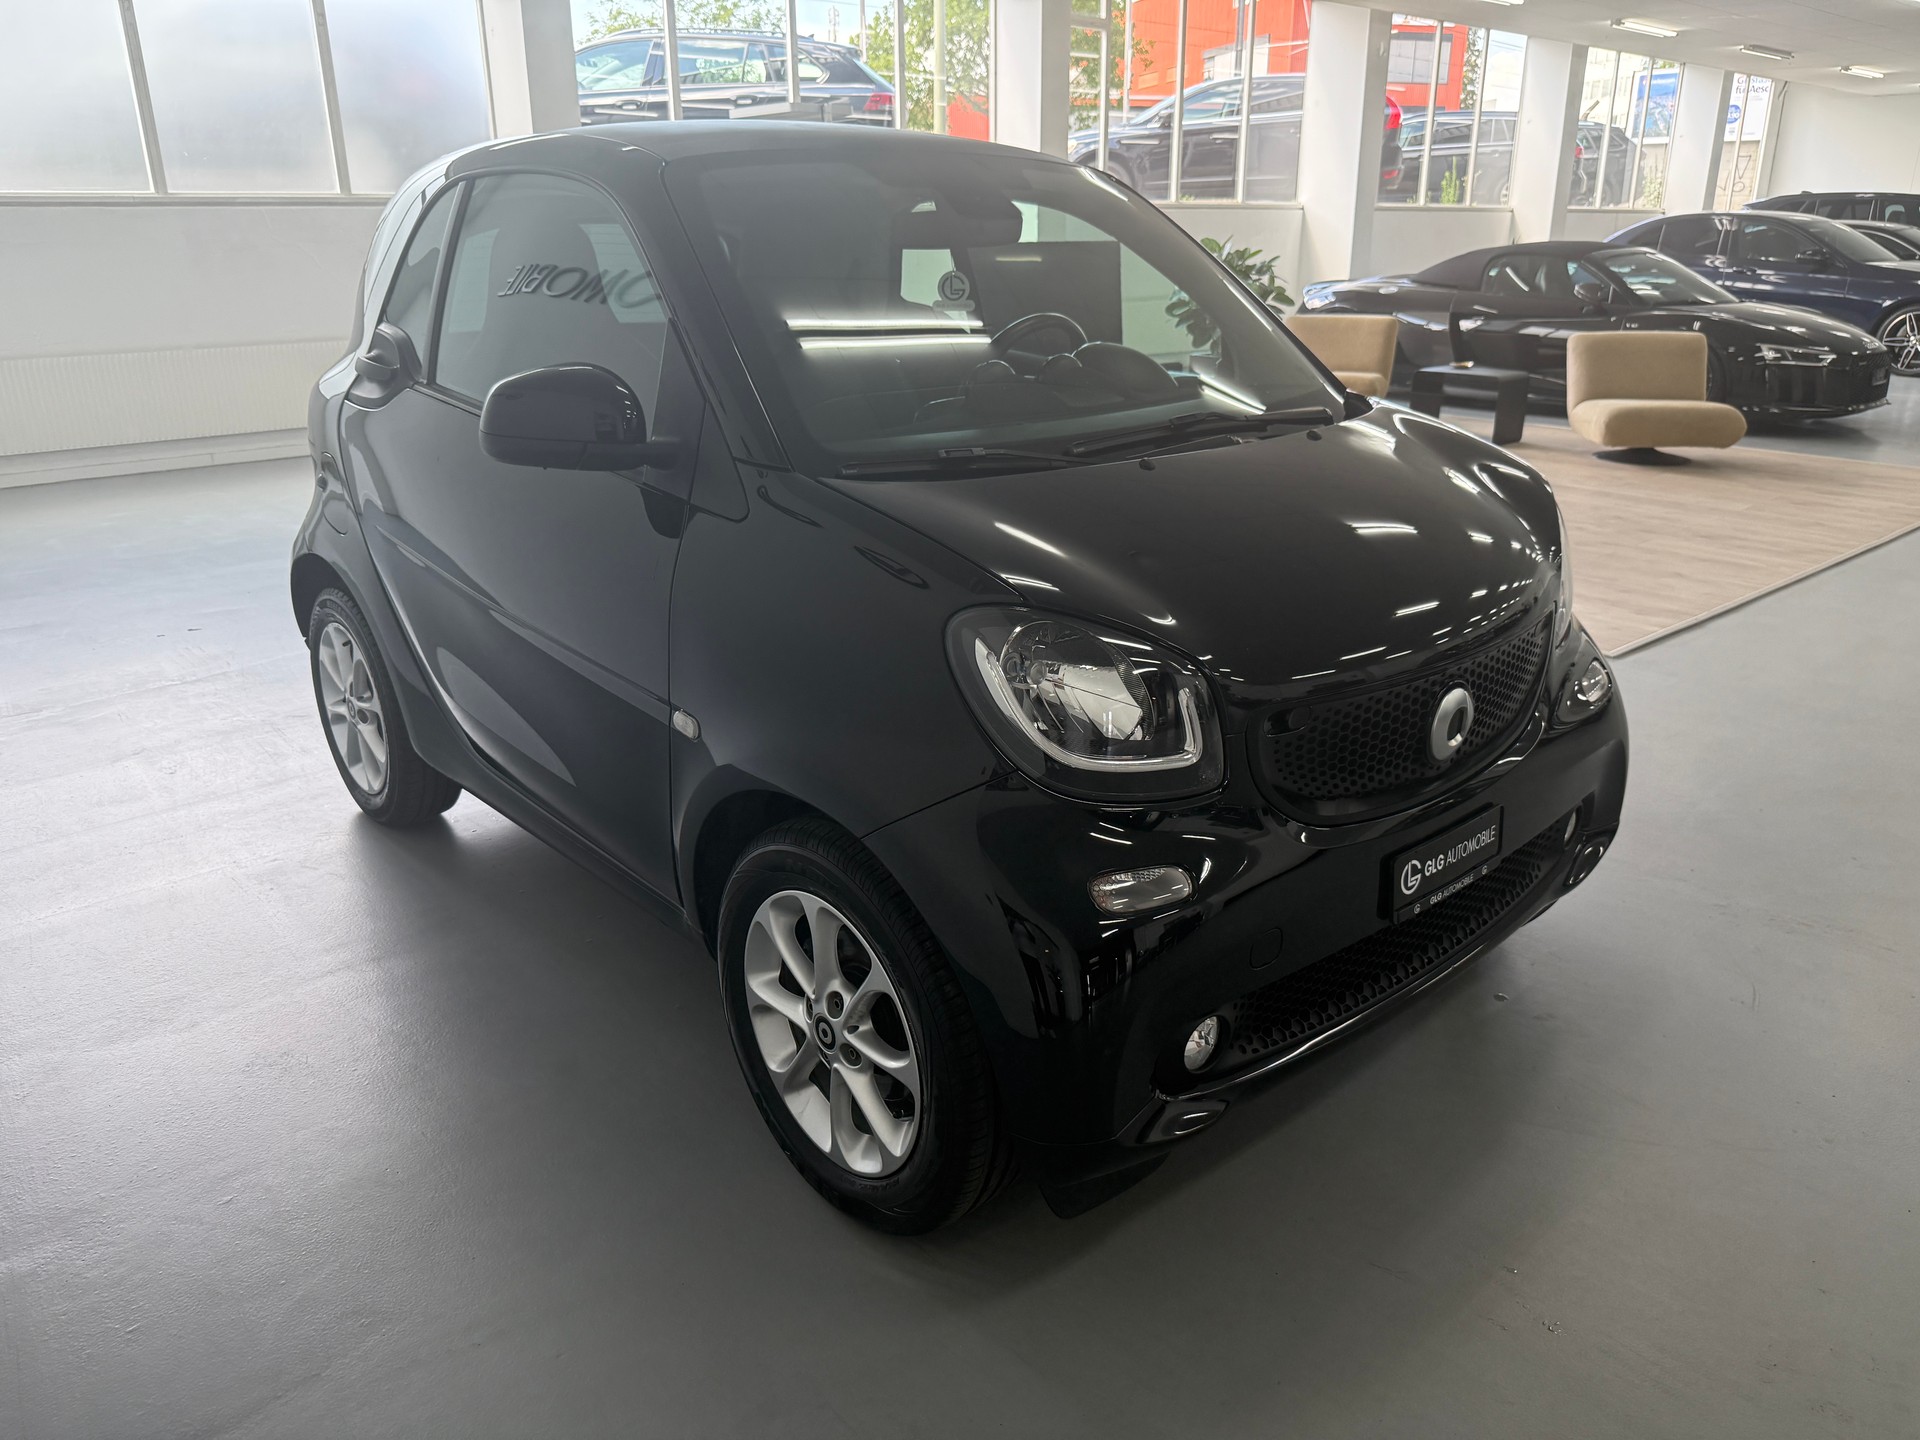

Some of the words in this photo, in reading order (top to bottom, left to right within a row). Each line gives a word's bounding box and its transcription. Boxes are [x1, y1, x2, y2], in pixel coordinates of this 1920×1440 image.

[1424, 854, 1445, 877] GLG
[1446, 824, 1496, 867] AUTOMOBILE
[1429, 892, 1442, 905] GLG
[1442, 873, 1474, 899] AUTOMOBILE
